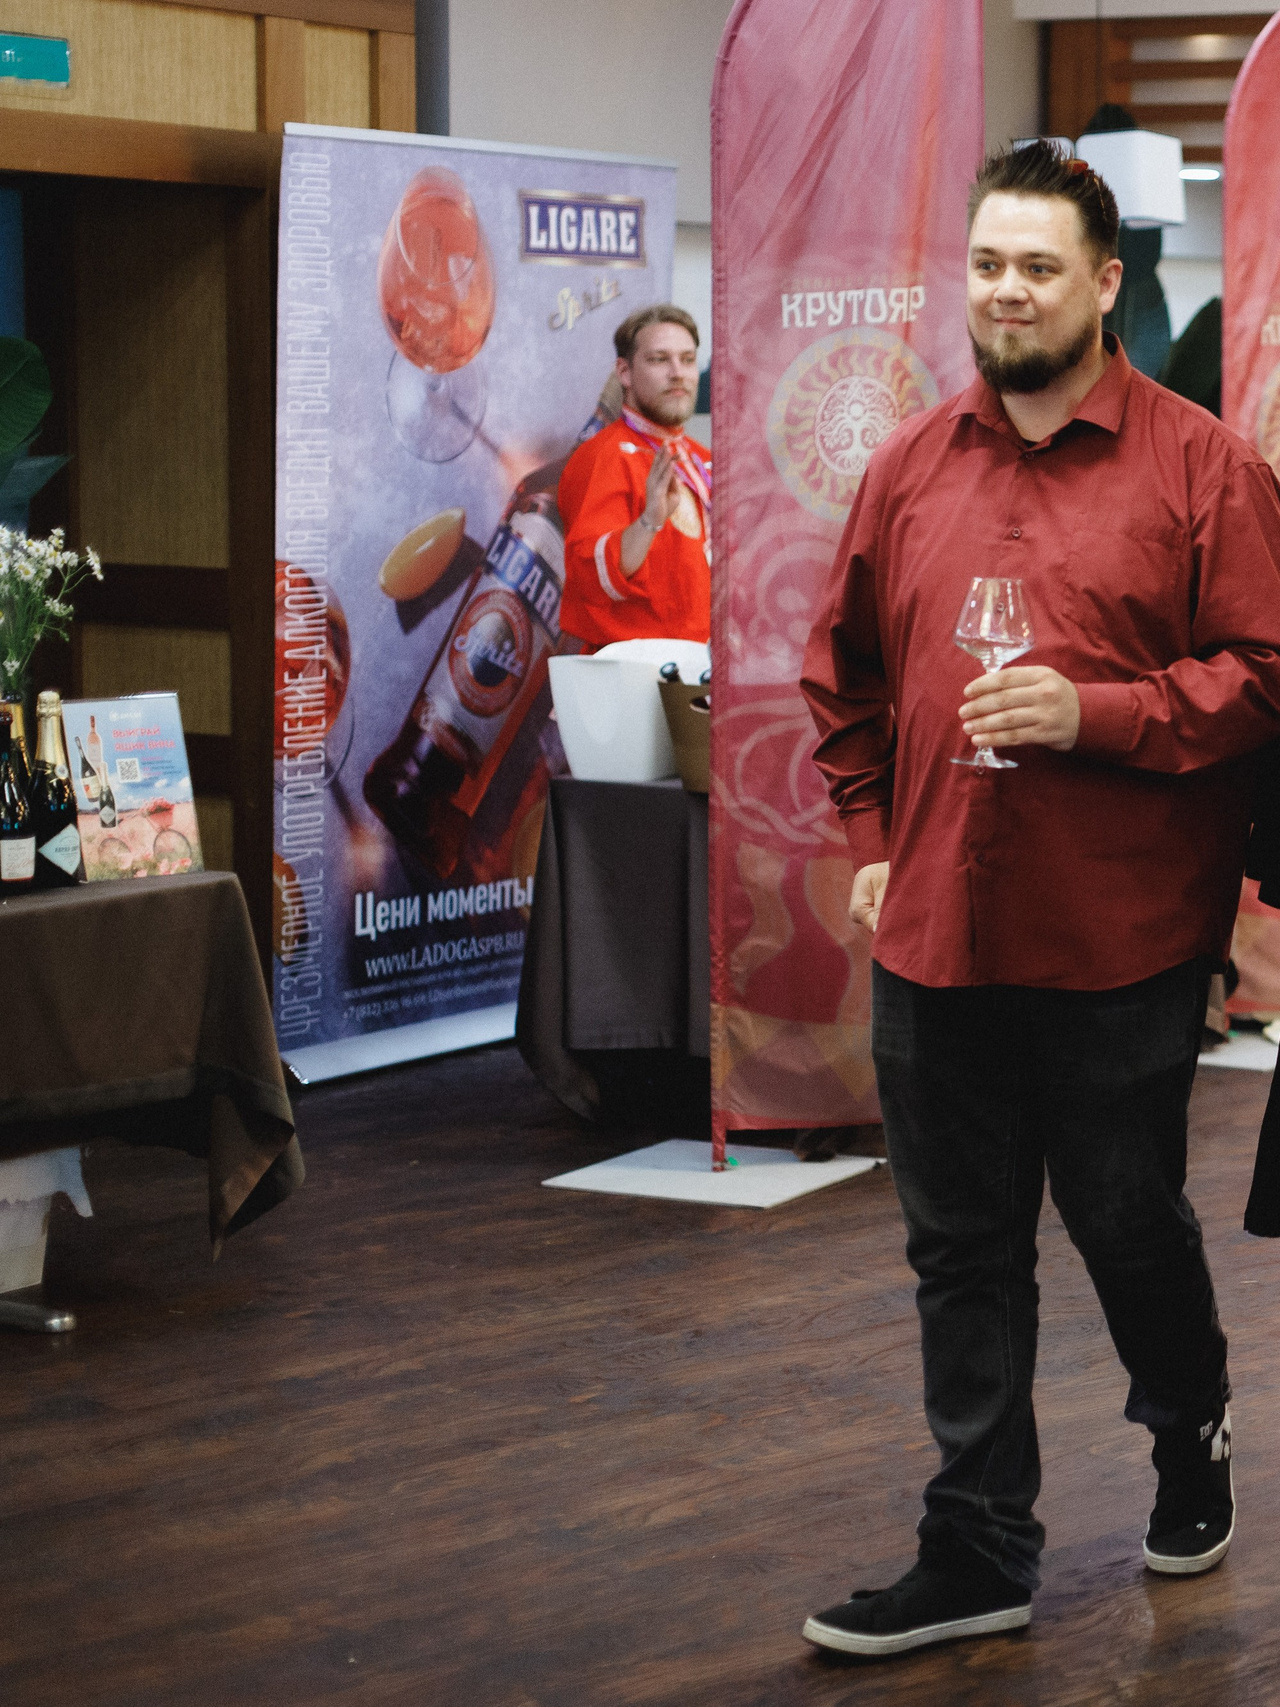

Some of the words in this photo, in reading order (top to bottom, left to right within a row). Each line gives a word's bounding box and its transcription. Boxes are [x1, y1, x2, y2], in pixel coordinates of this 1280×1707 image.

[528, 204, 637, 254] LIGARE
[285, 301, 332, 414] ВАШЕМУ
[781, 285, 927, 329] КРУТОЯР
[284, 424, 332, 518] ВРЕДИТ
[283, 528, 328, 659] АЛКОГОЛЯ
[280, 668, 327, 862] УПОТРЕБЛЕНИЕ
[279, 873, 324, 1038] ЧРЕЗМЕРНОЕ
[355, 891, 421, 941] Цени
[427, 875, 534, 924] моменты
